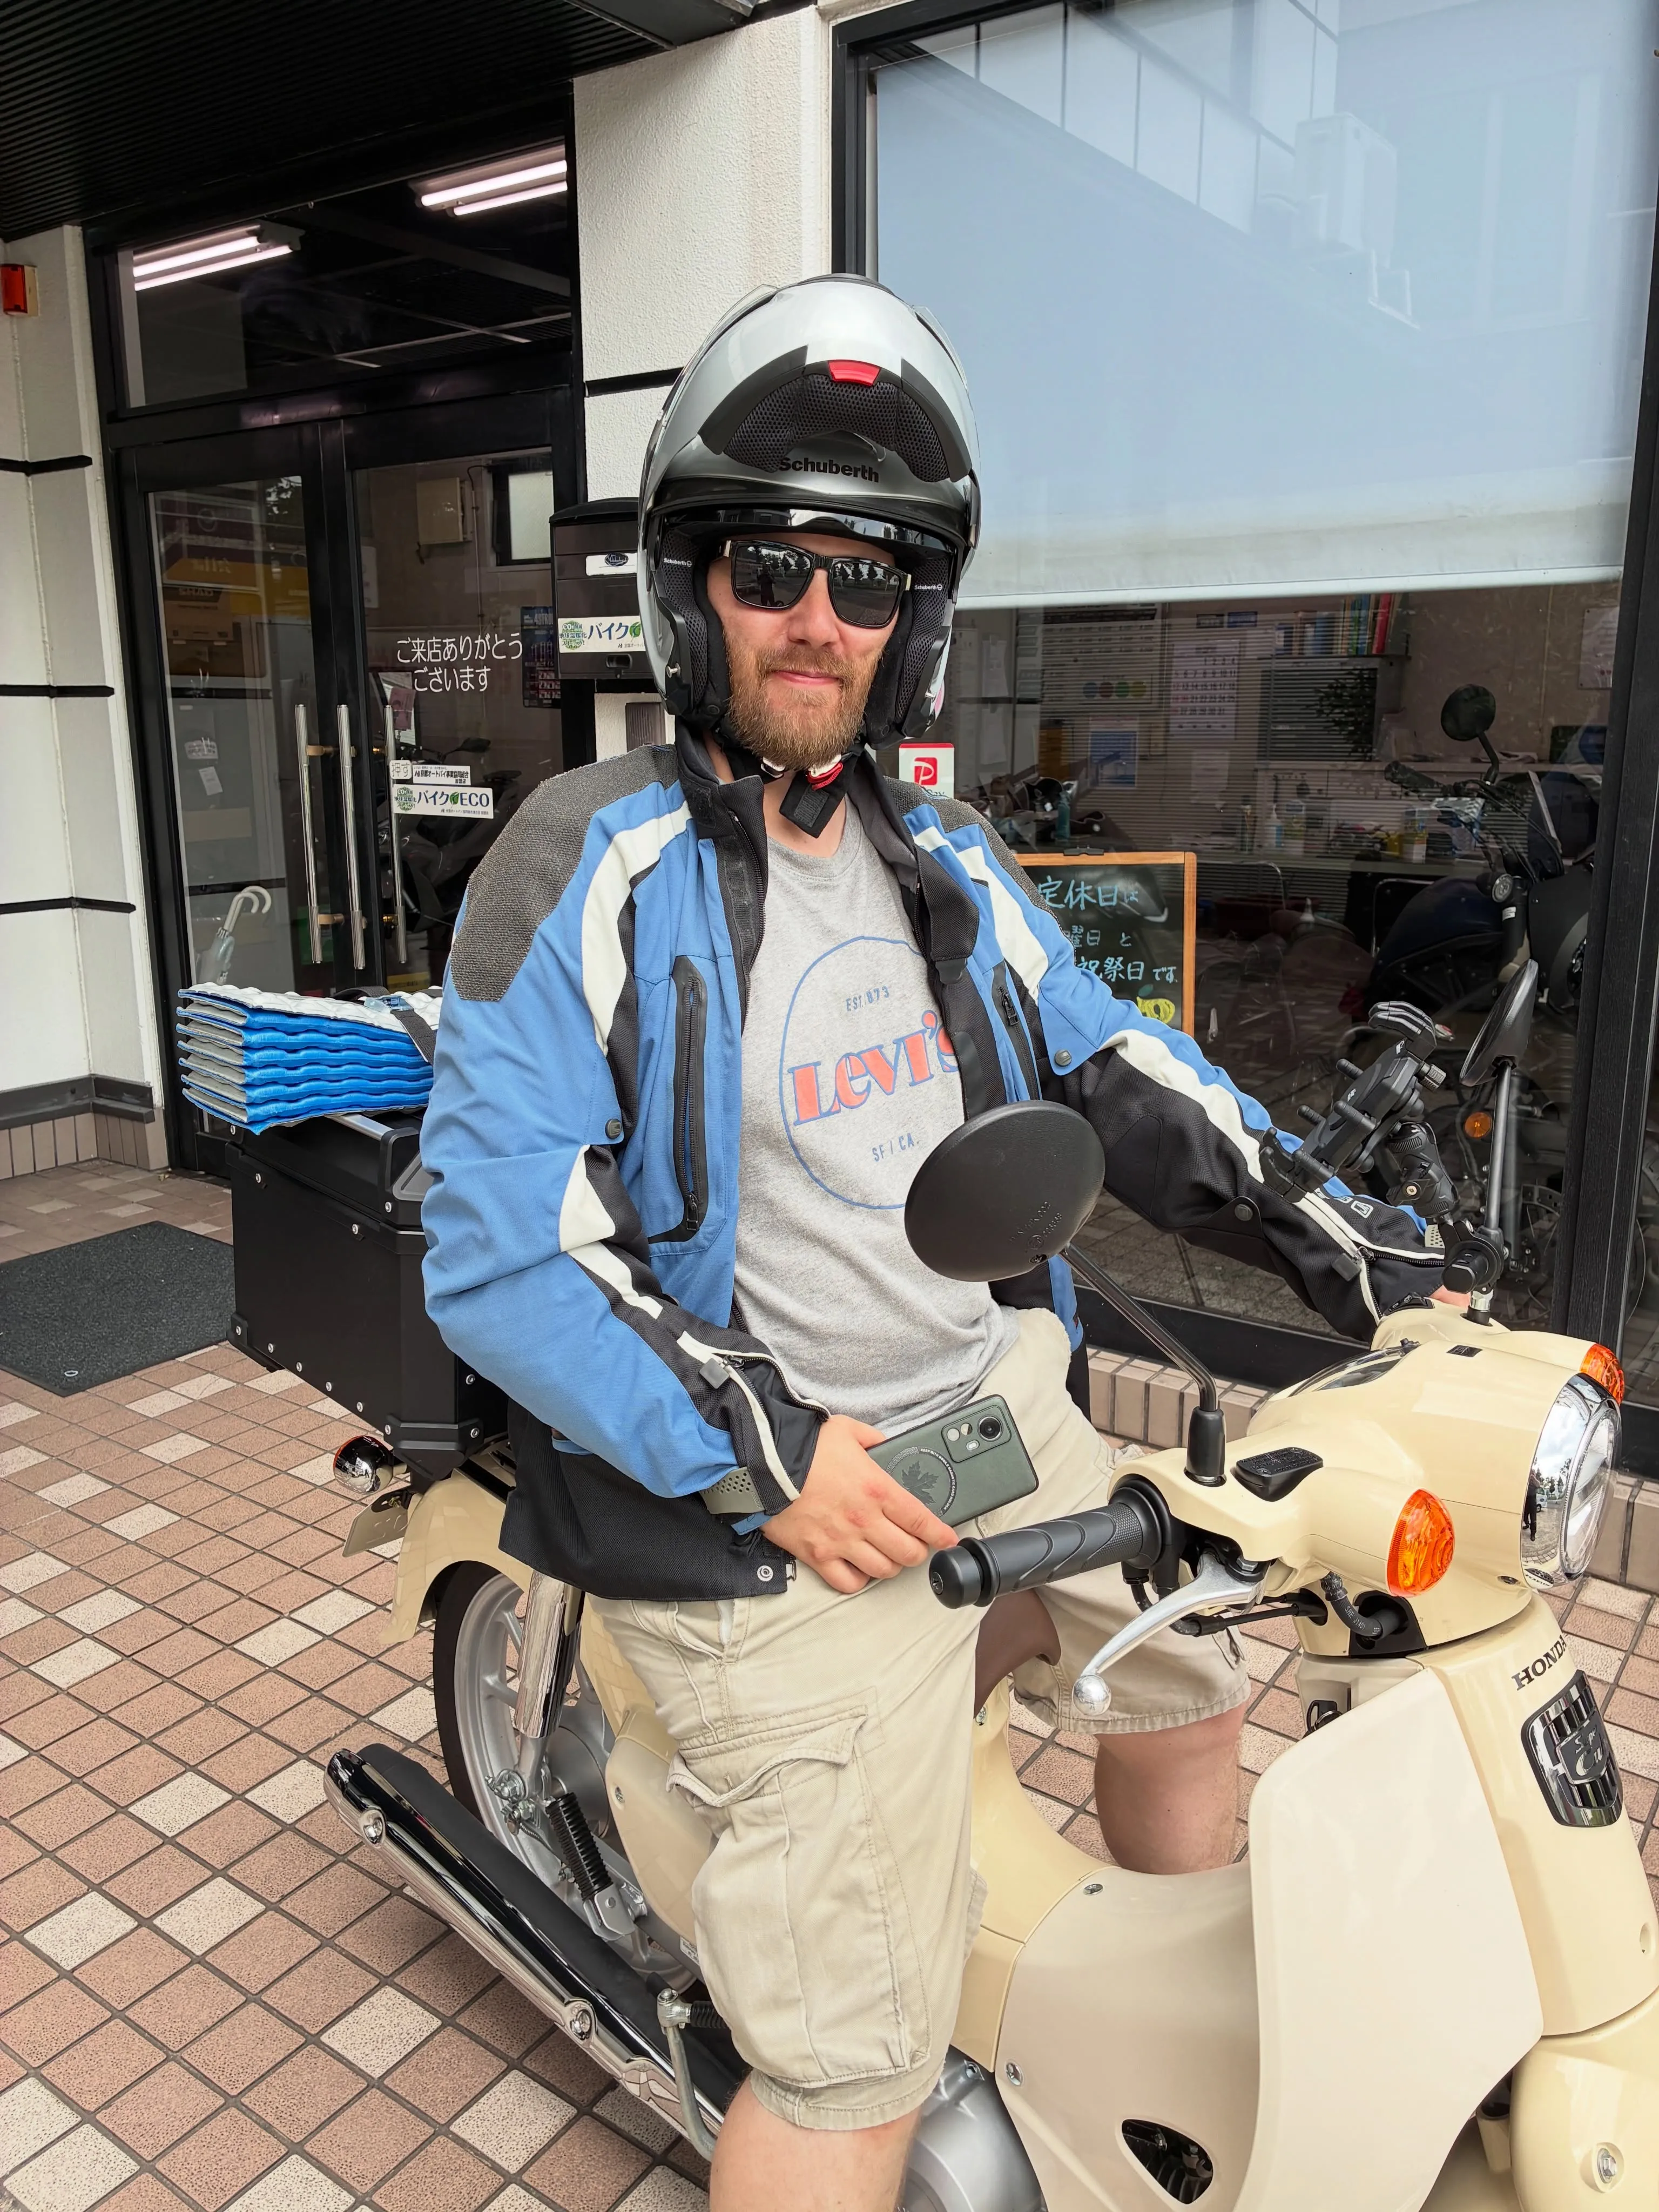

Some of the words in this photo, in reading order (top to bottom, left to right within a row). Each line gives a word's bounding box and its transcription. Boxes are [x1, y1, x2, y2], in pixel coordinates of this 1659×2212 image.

[779, 456, 879, 483] Schuberth
[663, 557, 686, 566] Schuberth
[588, 622, 629, 640] バイク
[397, 632, 523, 663] ご来店ありがとう
[414, 665, 491, 692] ございます
[392, 762, 410, 777] 押す
[417, 790, 449, 806] バイク
[460, 792, 490, 807] ECO
[1038, 875, 1139, 911] 定休日は
[1120, 932, 1132, 947] と
[846, 995, 864, 1012] EST.
[872, 1144, 885, 1162] SF
[1511, 1634, 1567, 1691] HONDA
